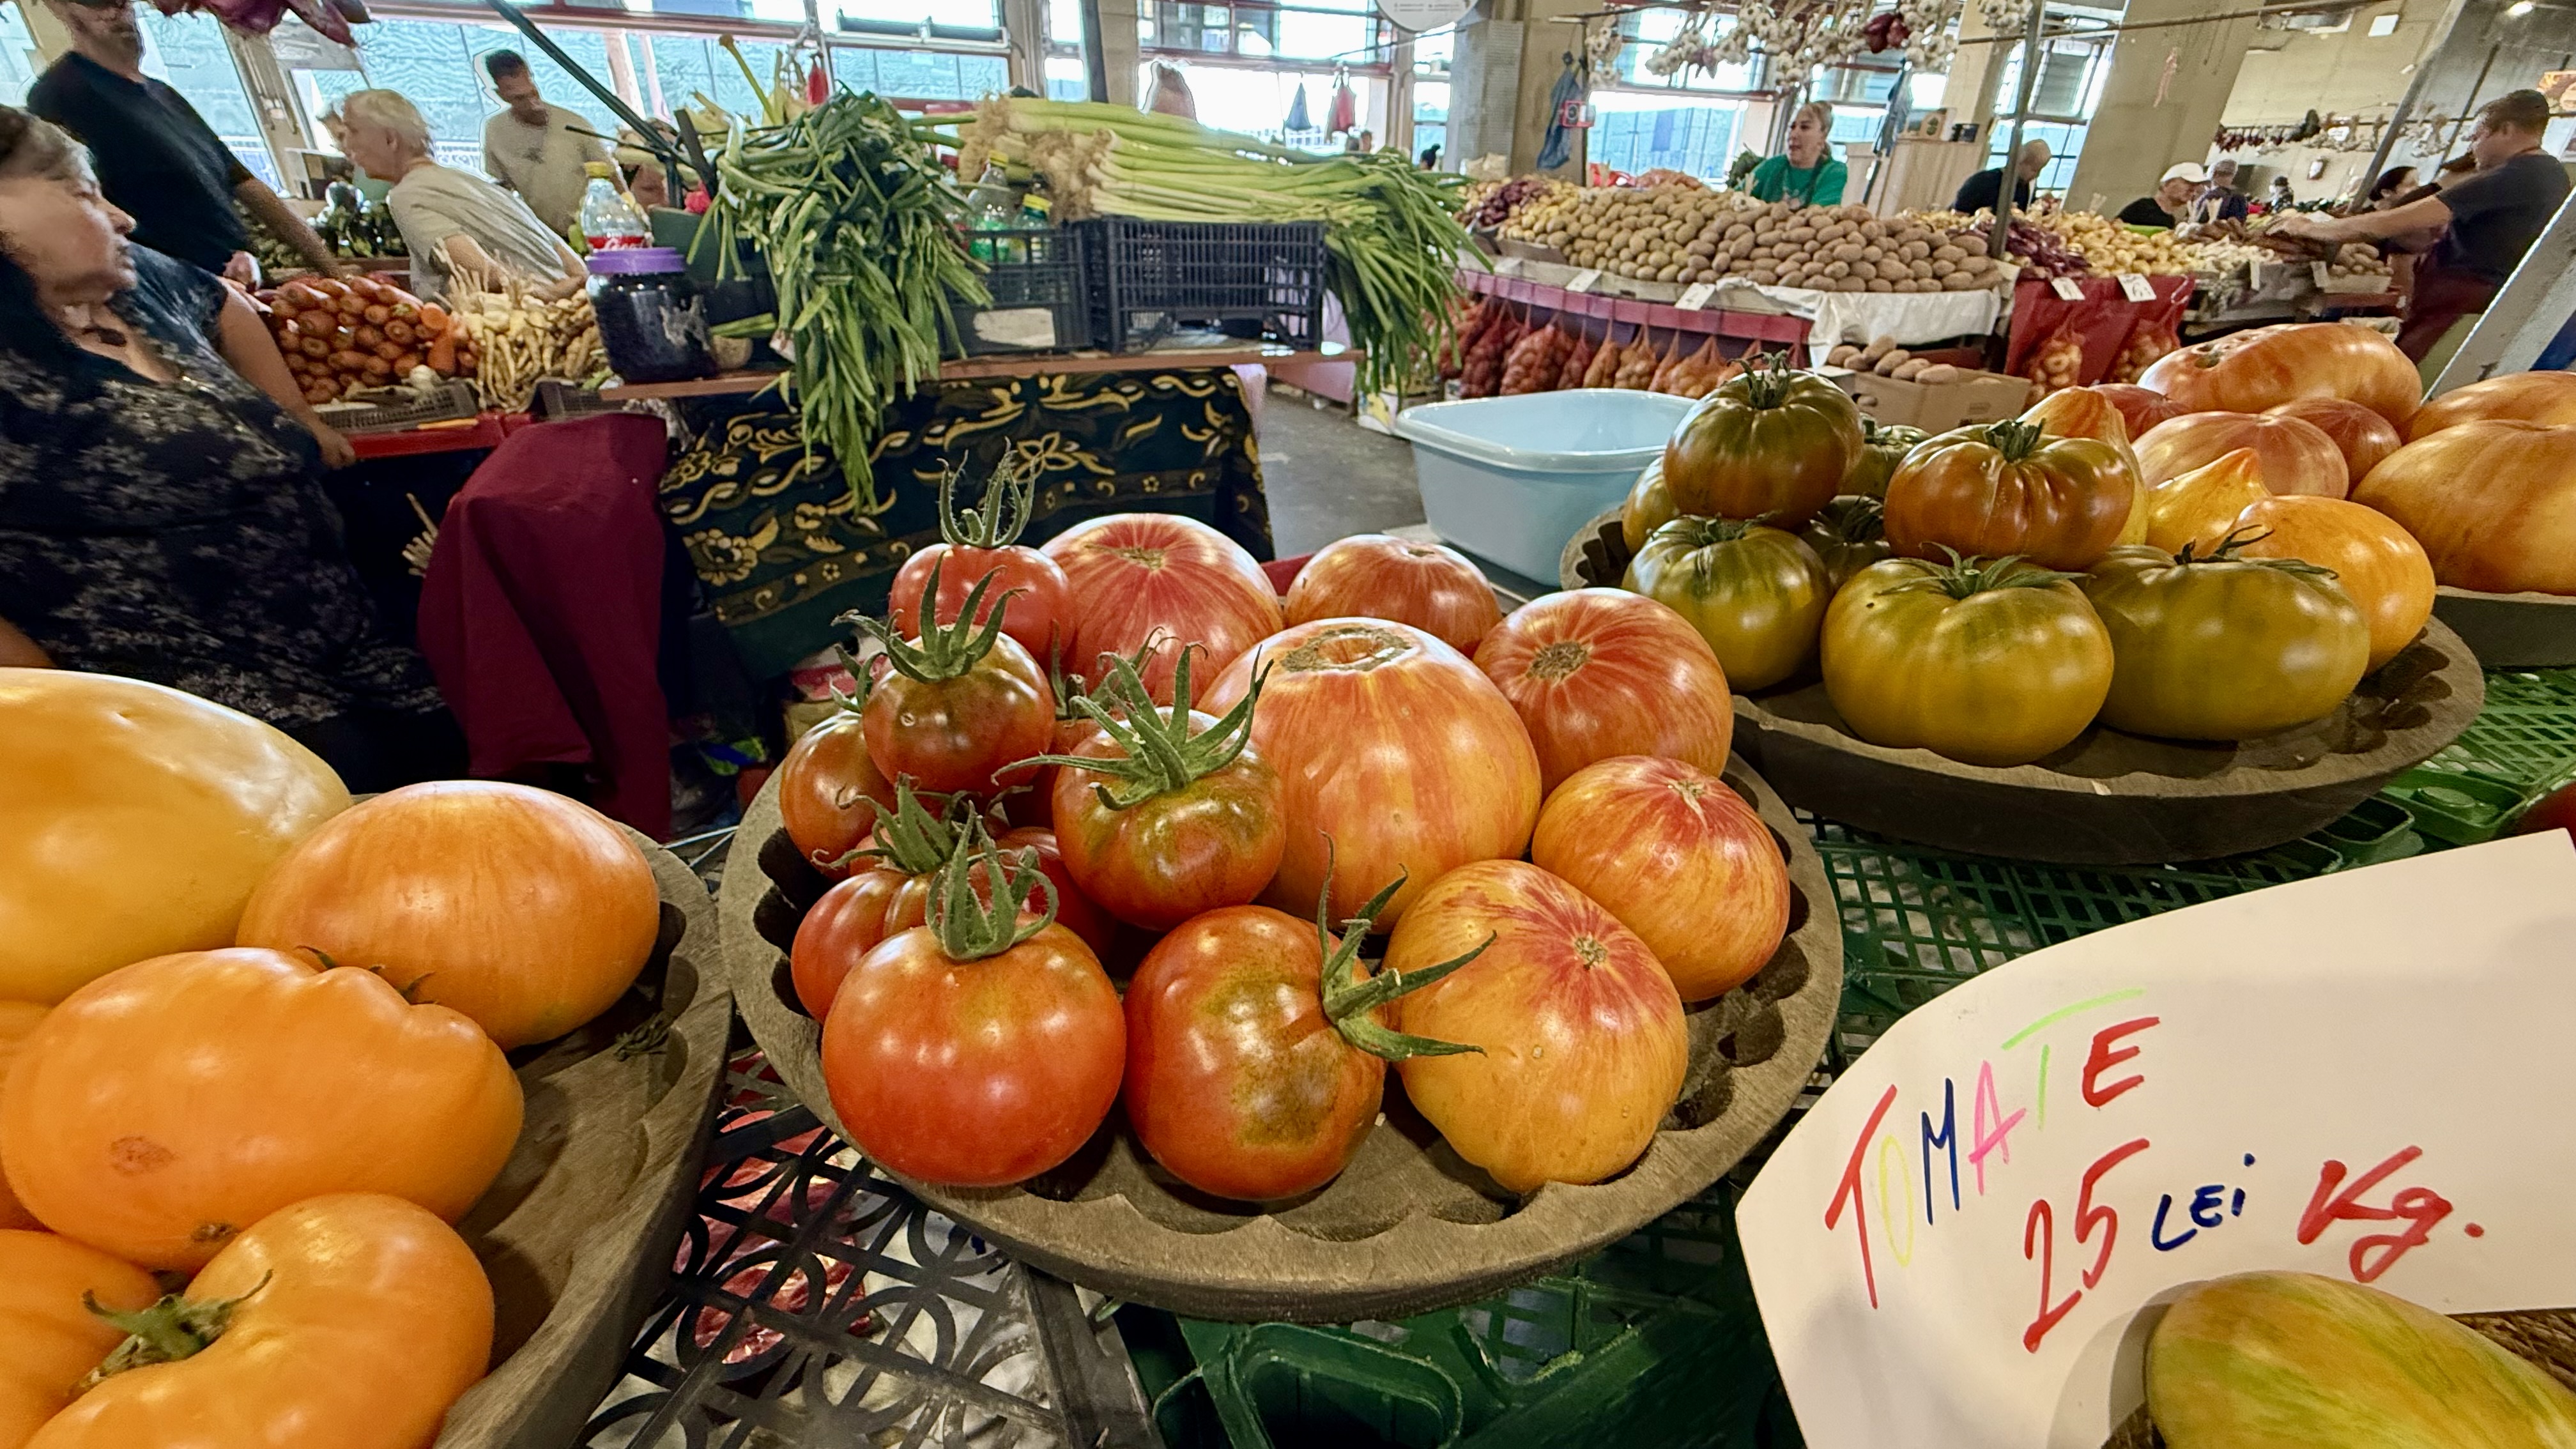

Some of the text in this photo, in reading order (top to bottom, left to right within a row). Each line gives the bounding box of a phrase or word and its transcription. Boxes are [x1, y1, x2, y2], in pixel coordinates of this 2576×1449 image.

[1825, 988, 2160, 1310] TOMATE
[2023, 1139, 2150, 1354] 25
[2298, 1145, 2485, 1282] Kg.
